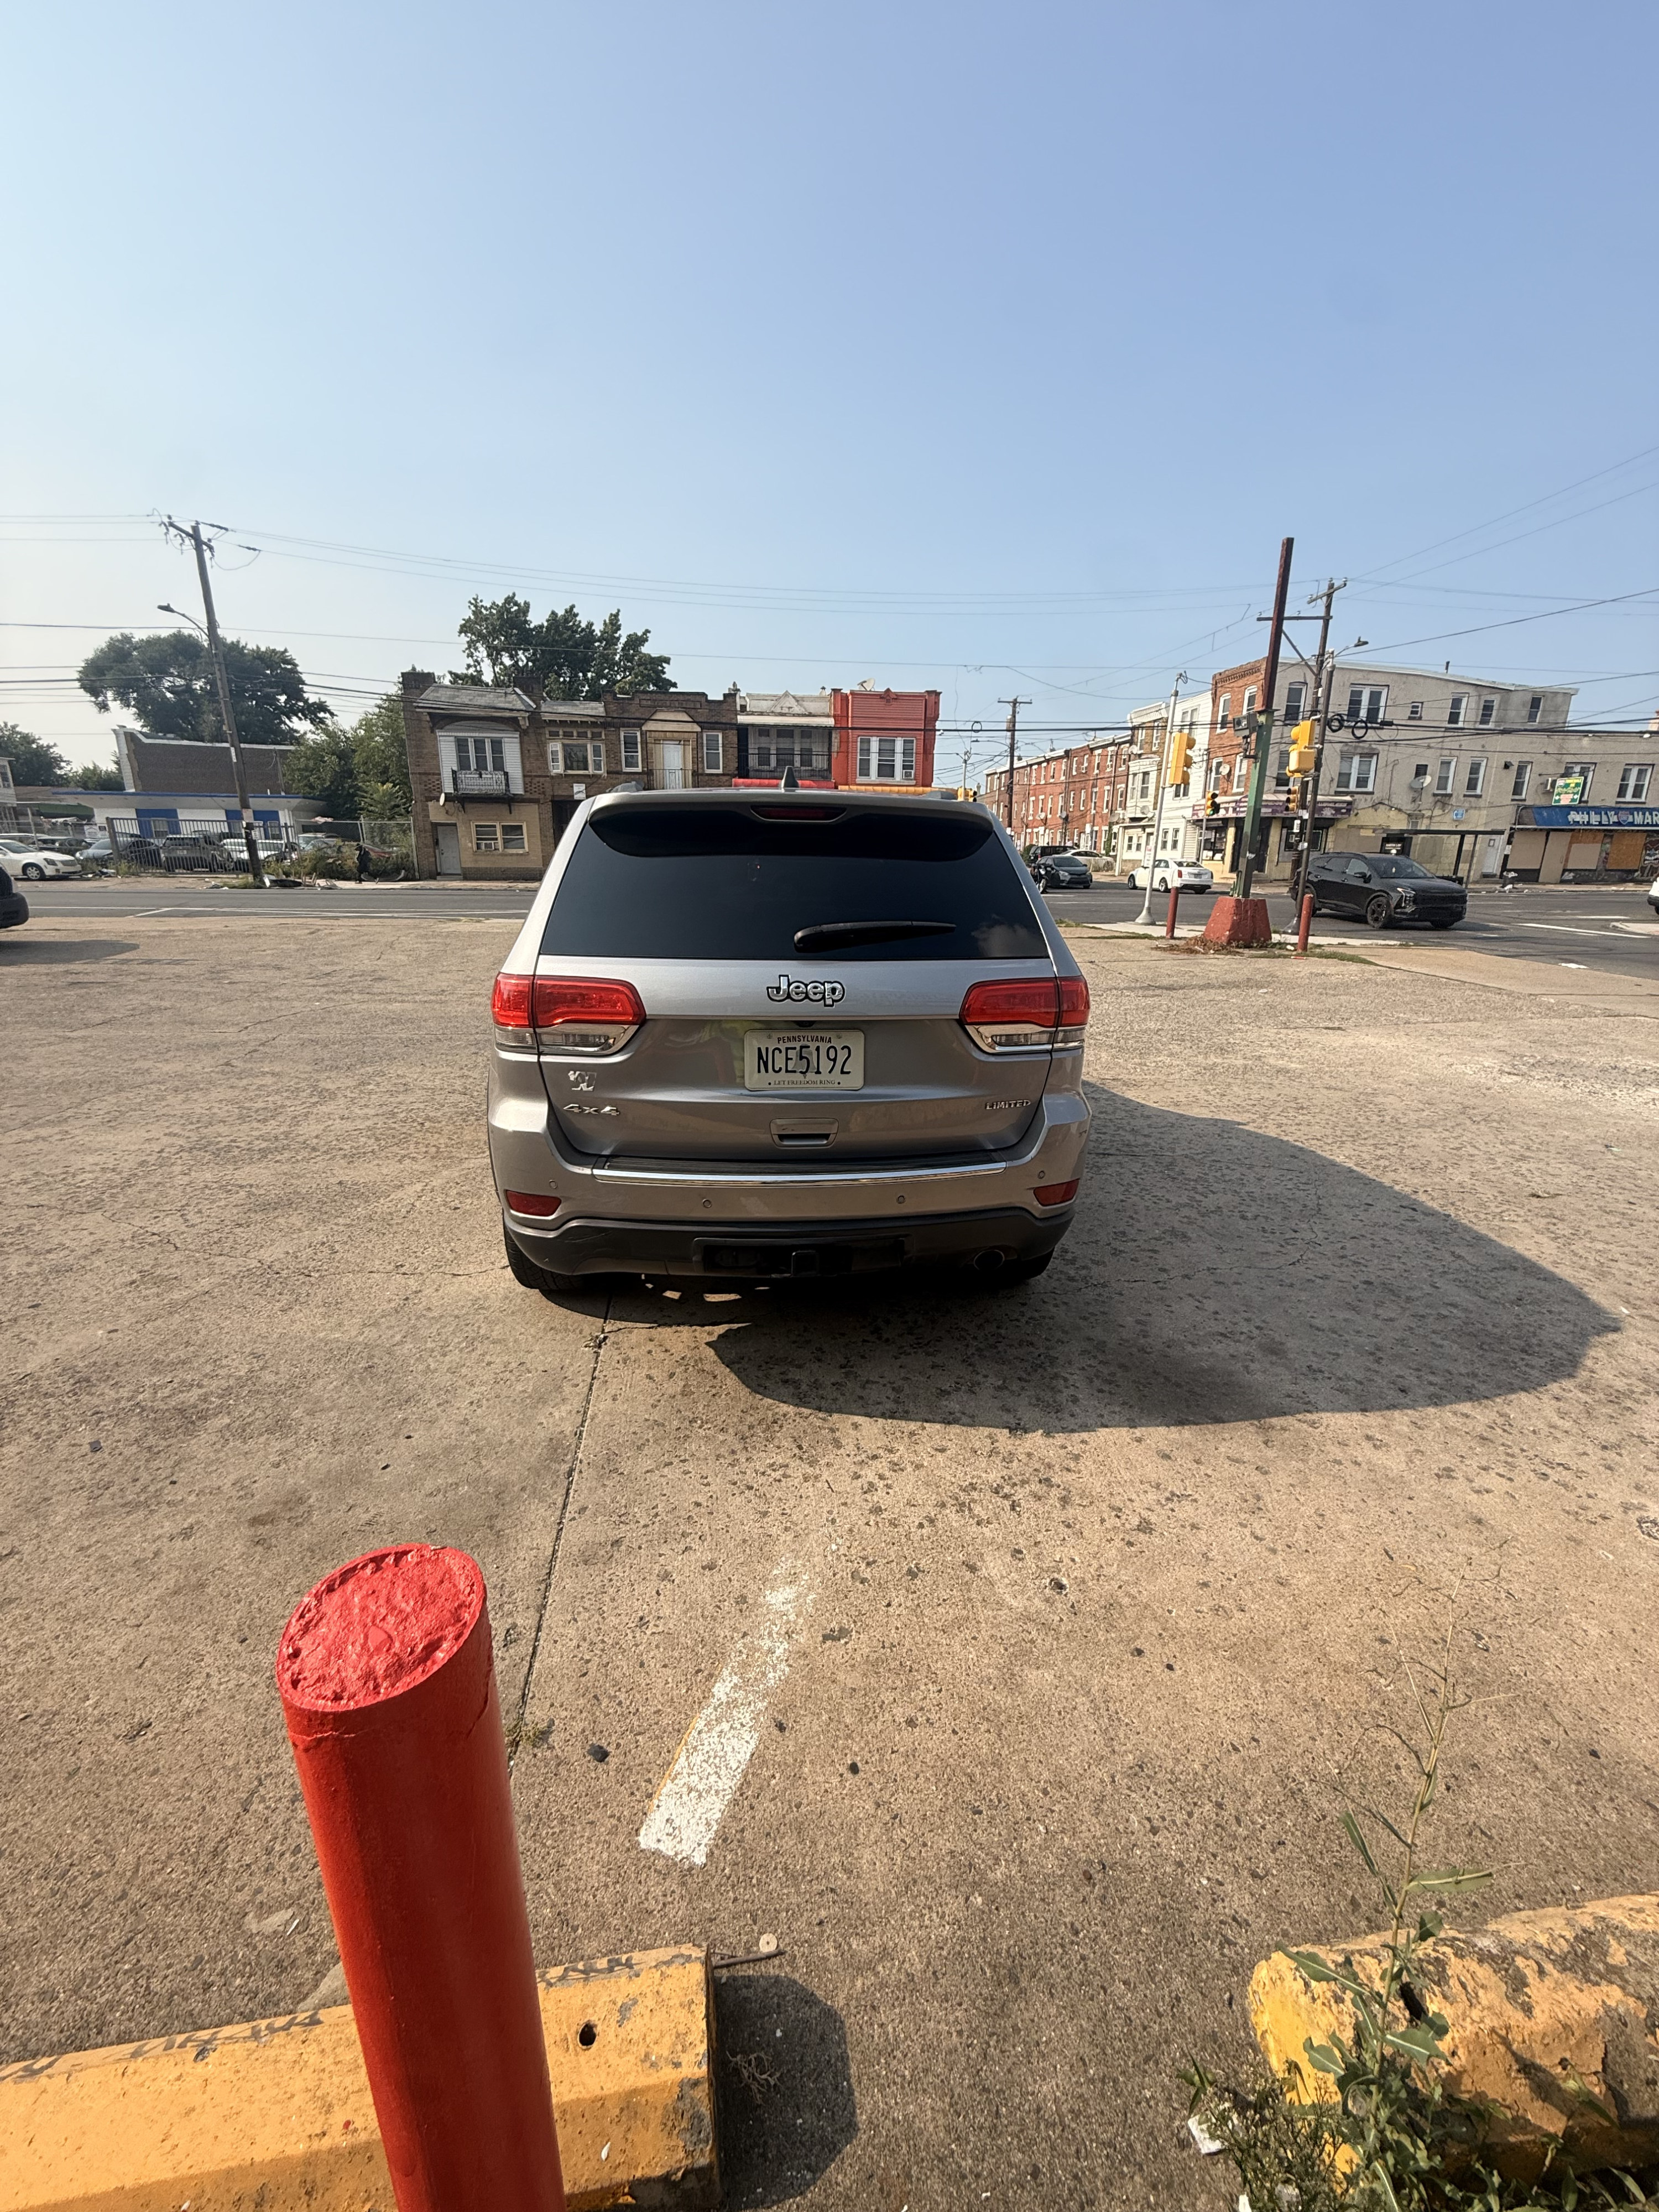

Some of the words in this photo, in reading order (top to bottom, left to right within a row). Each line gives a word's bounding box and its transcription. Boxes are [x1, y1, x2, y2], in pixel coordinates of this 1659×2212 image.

[1568, 811, 1615, 825] PHILLY
[766, 974, 846, 1007] Jeep
[777, 1035, 832, 1044] PENNSYLVANIA
[757, 1045, 852, 1074] NCE5192
[563, 1104, 620, 1116] 4x4
[985, 1099, 1031, 1110] LIMITED
